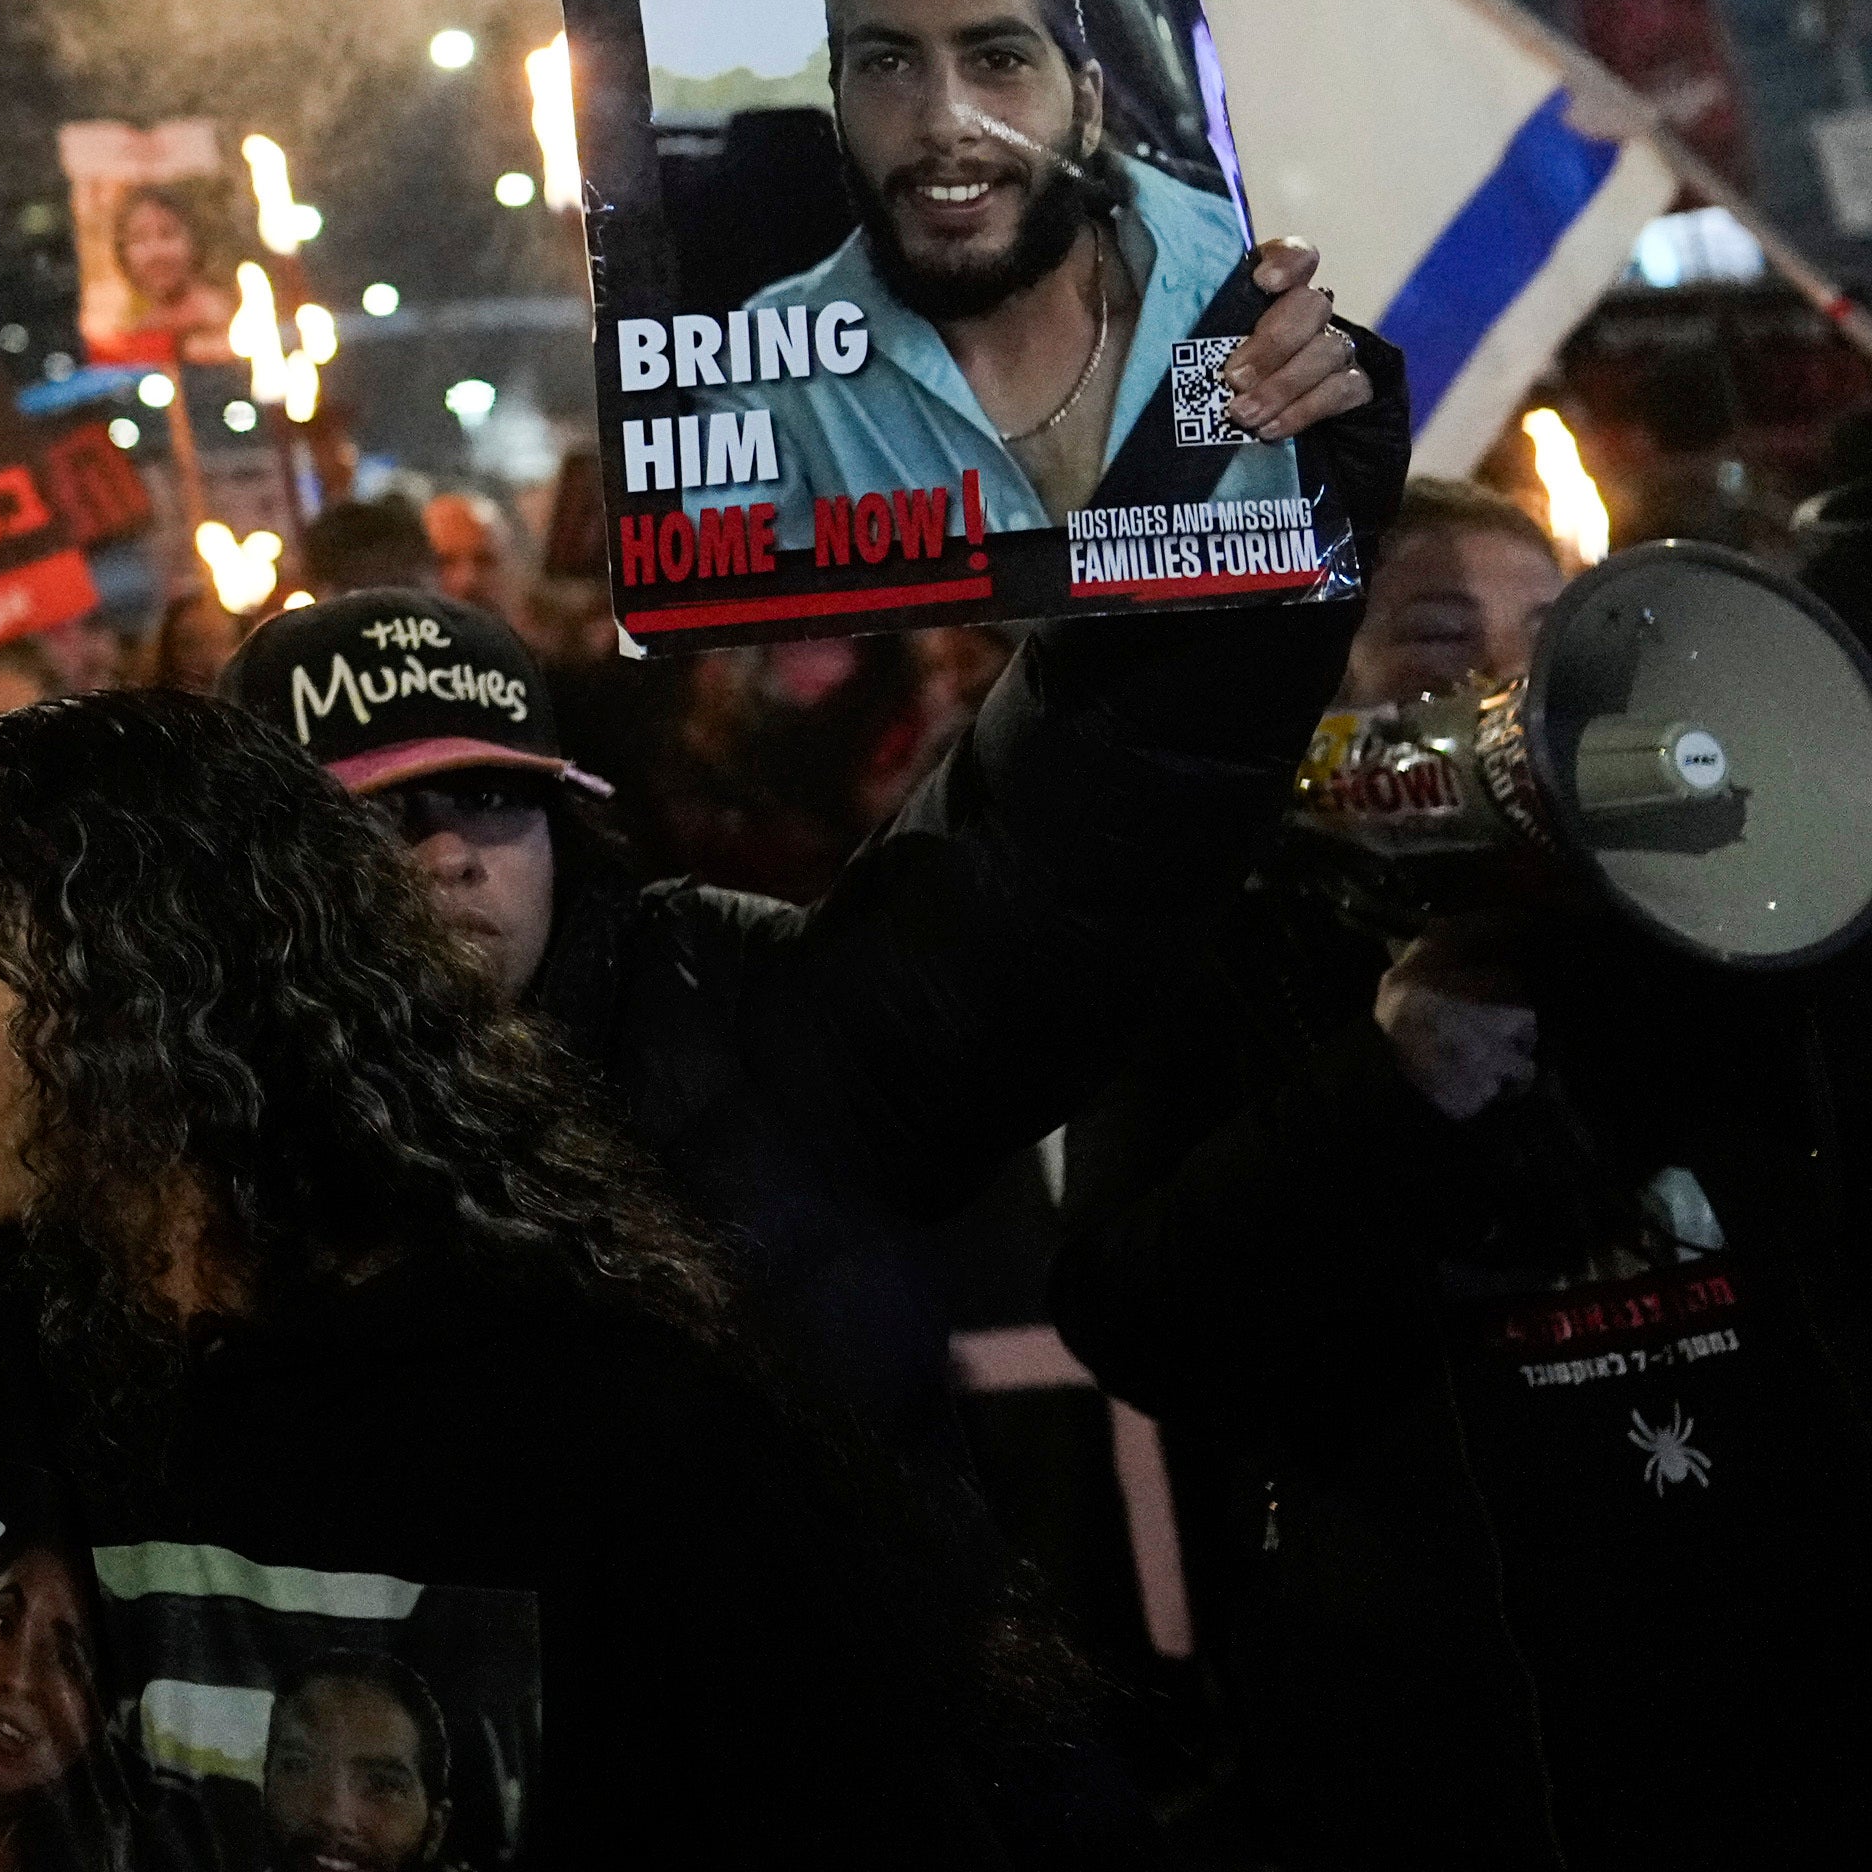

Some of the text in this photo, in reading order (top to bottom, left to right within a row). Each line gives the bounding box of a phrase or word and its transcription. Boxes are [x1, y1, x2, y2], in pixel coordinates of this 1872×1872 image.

[617, 300, 868, 392] BRING
[622, 409, 779, 493] HIM
[620, 501, 776, 587] HOME
[1067, 497, 1313, 540] HOSTAGES AND MISSING
[1069, 529, 1319, 584] FAMILIES FORUM
